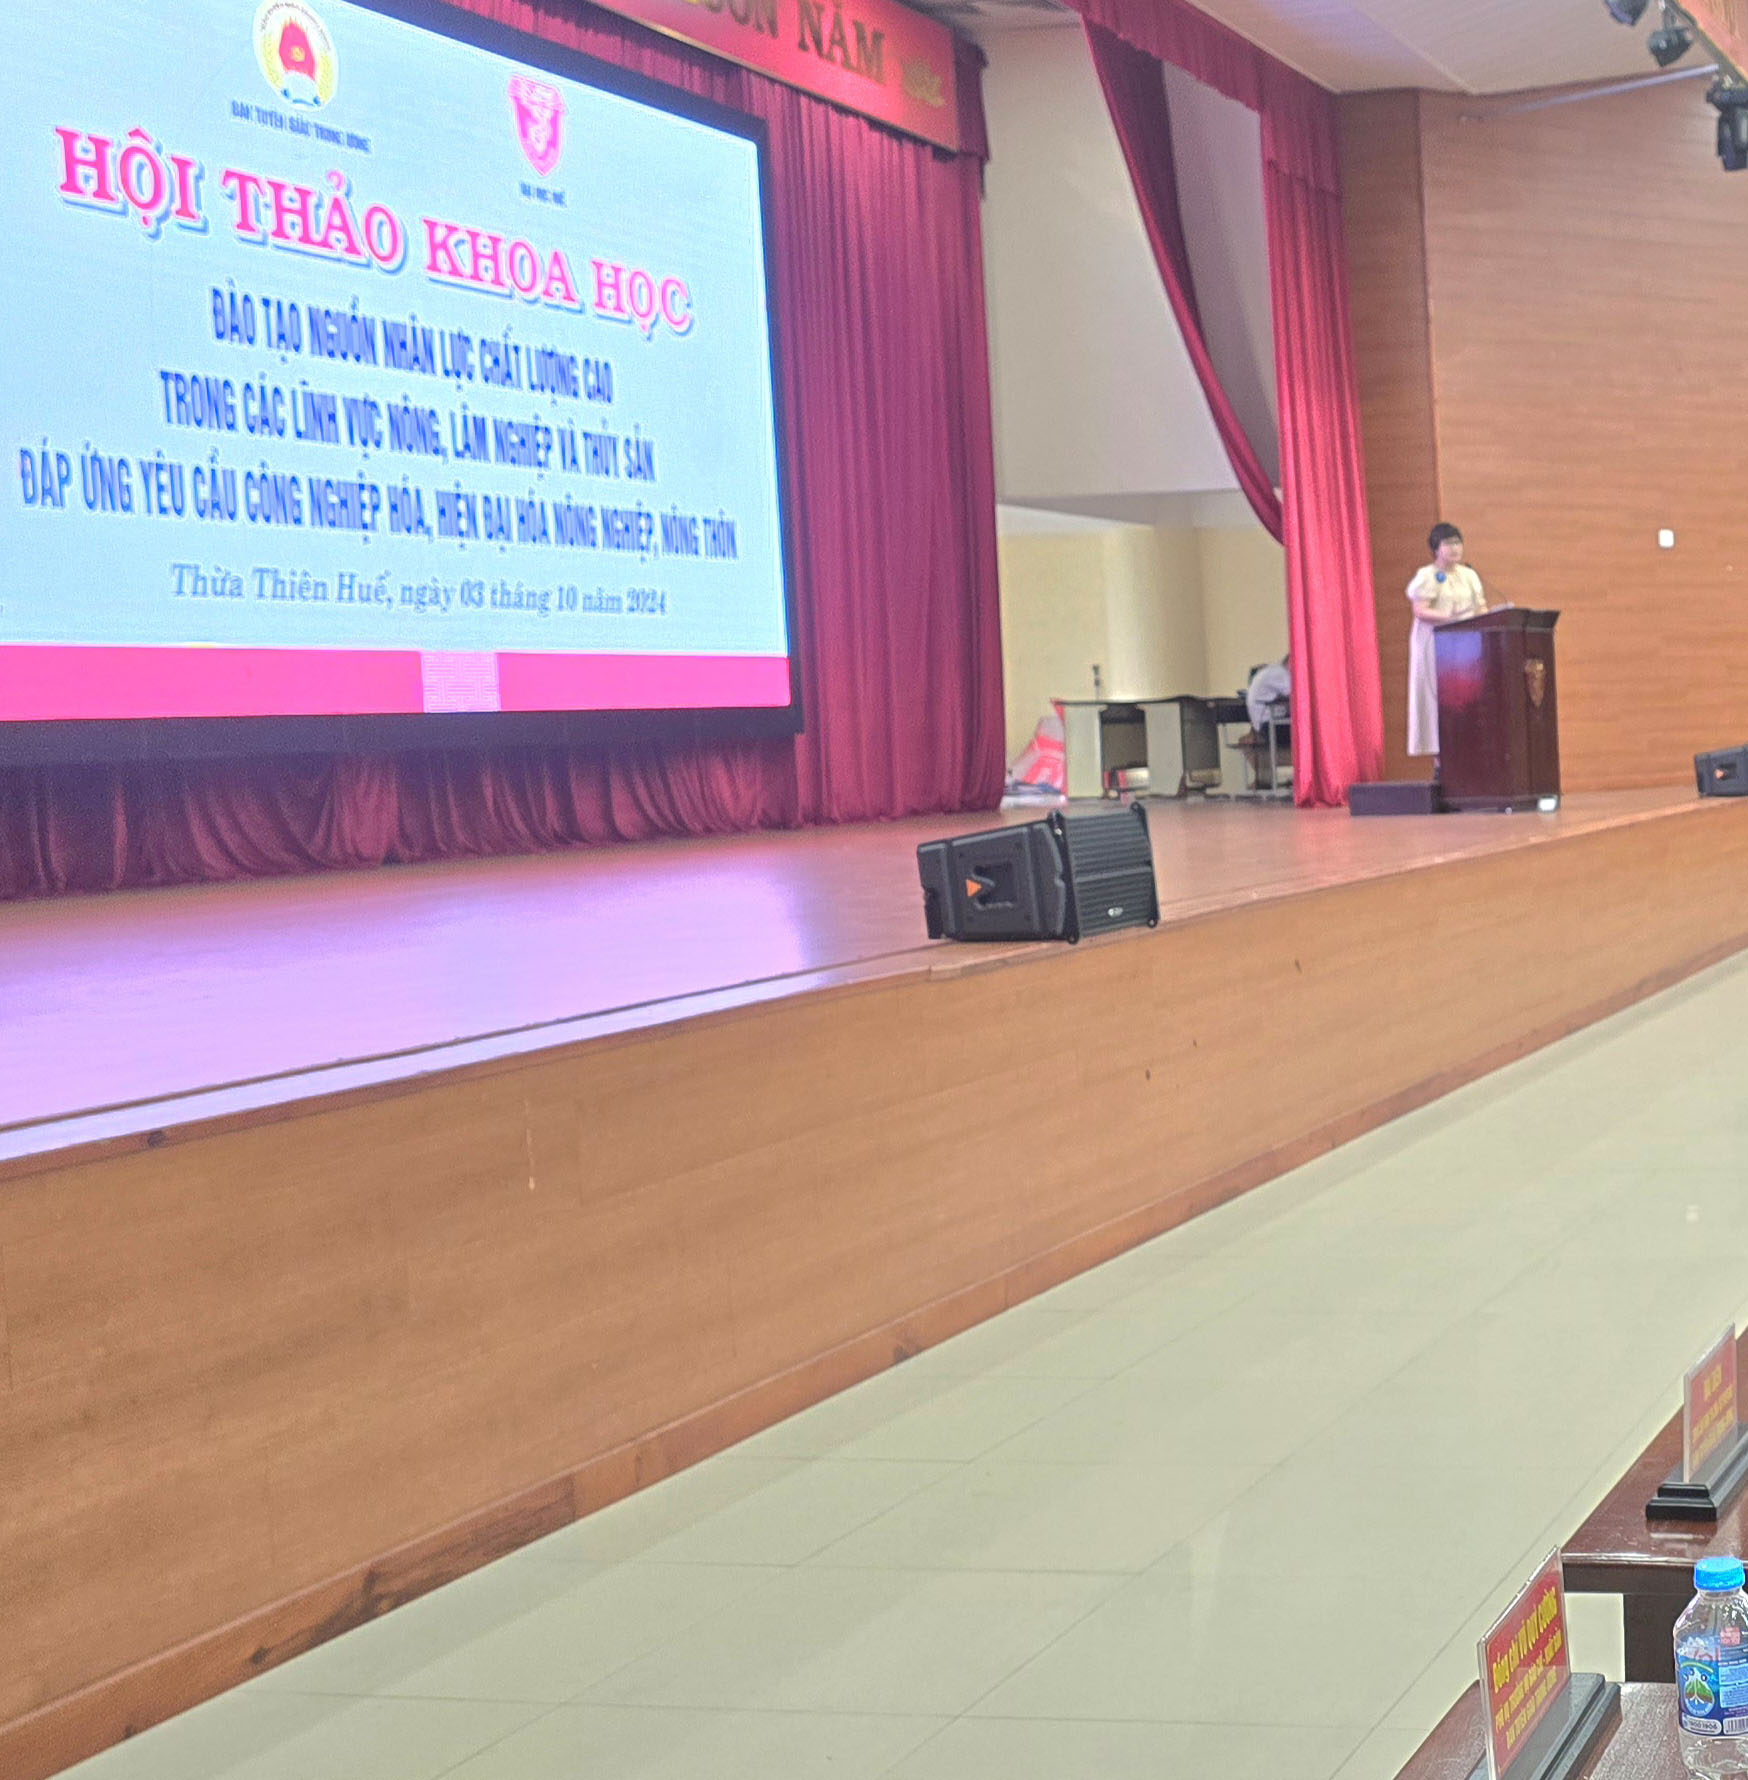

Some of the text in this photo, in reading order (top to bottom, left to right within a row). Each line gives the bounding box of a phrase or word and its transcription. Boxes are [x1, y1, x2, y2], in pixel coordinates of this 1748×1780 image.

[54, 126, 693, 340] HỘI THẢO KHOA HỌC
[212, 278, 613, 405] ĐÀO TẠO NGUỒN NHÂN LỰC CHẤT LƯỢNG CAO
[159, 370, 237, 431] TRONG
[243, 371, 286, 438] CÁC
[292, 379, 339, 443] LĨNH
[342, 393, 384, 459] VỰC
[450, 402, 491, 461] LÂM
[493, 412, 553, 479] NGHIỆP
[557, 417, 581, 474] VÀ
[623, 423, 656, 482] SẢN
[20, 437, 72, 508] ĐÁP
[82, 441, 134, 513] ỨNG
[140, 449, 185, 516] YÊU
[193, 446, 238, 521] CẦU
[245, 460, 301, 525] CÔNG
[308, 470, 381, 545] NGHIỆP
[435, 480, 479, 549] HIỆN
[483, 494, 514, 553] ĐẠI
[515, 487, 551, 545] HÓA
[553, 492, 599, 549] NÔNG
[660, 504, 700, 557] NÔNG
[702, 508, 738, 559] THÔN
[171, 562, 667, 617] Thừa Thiên Huế, ngày 03 tháng 10 năm 2024
